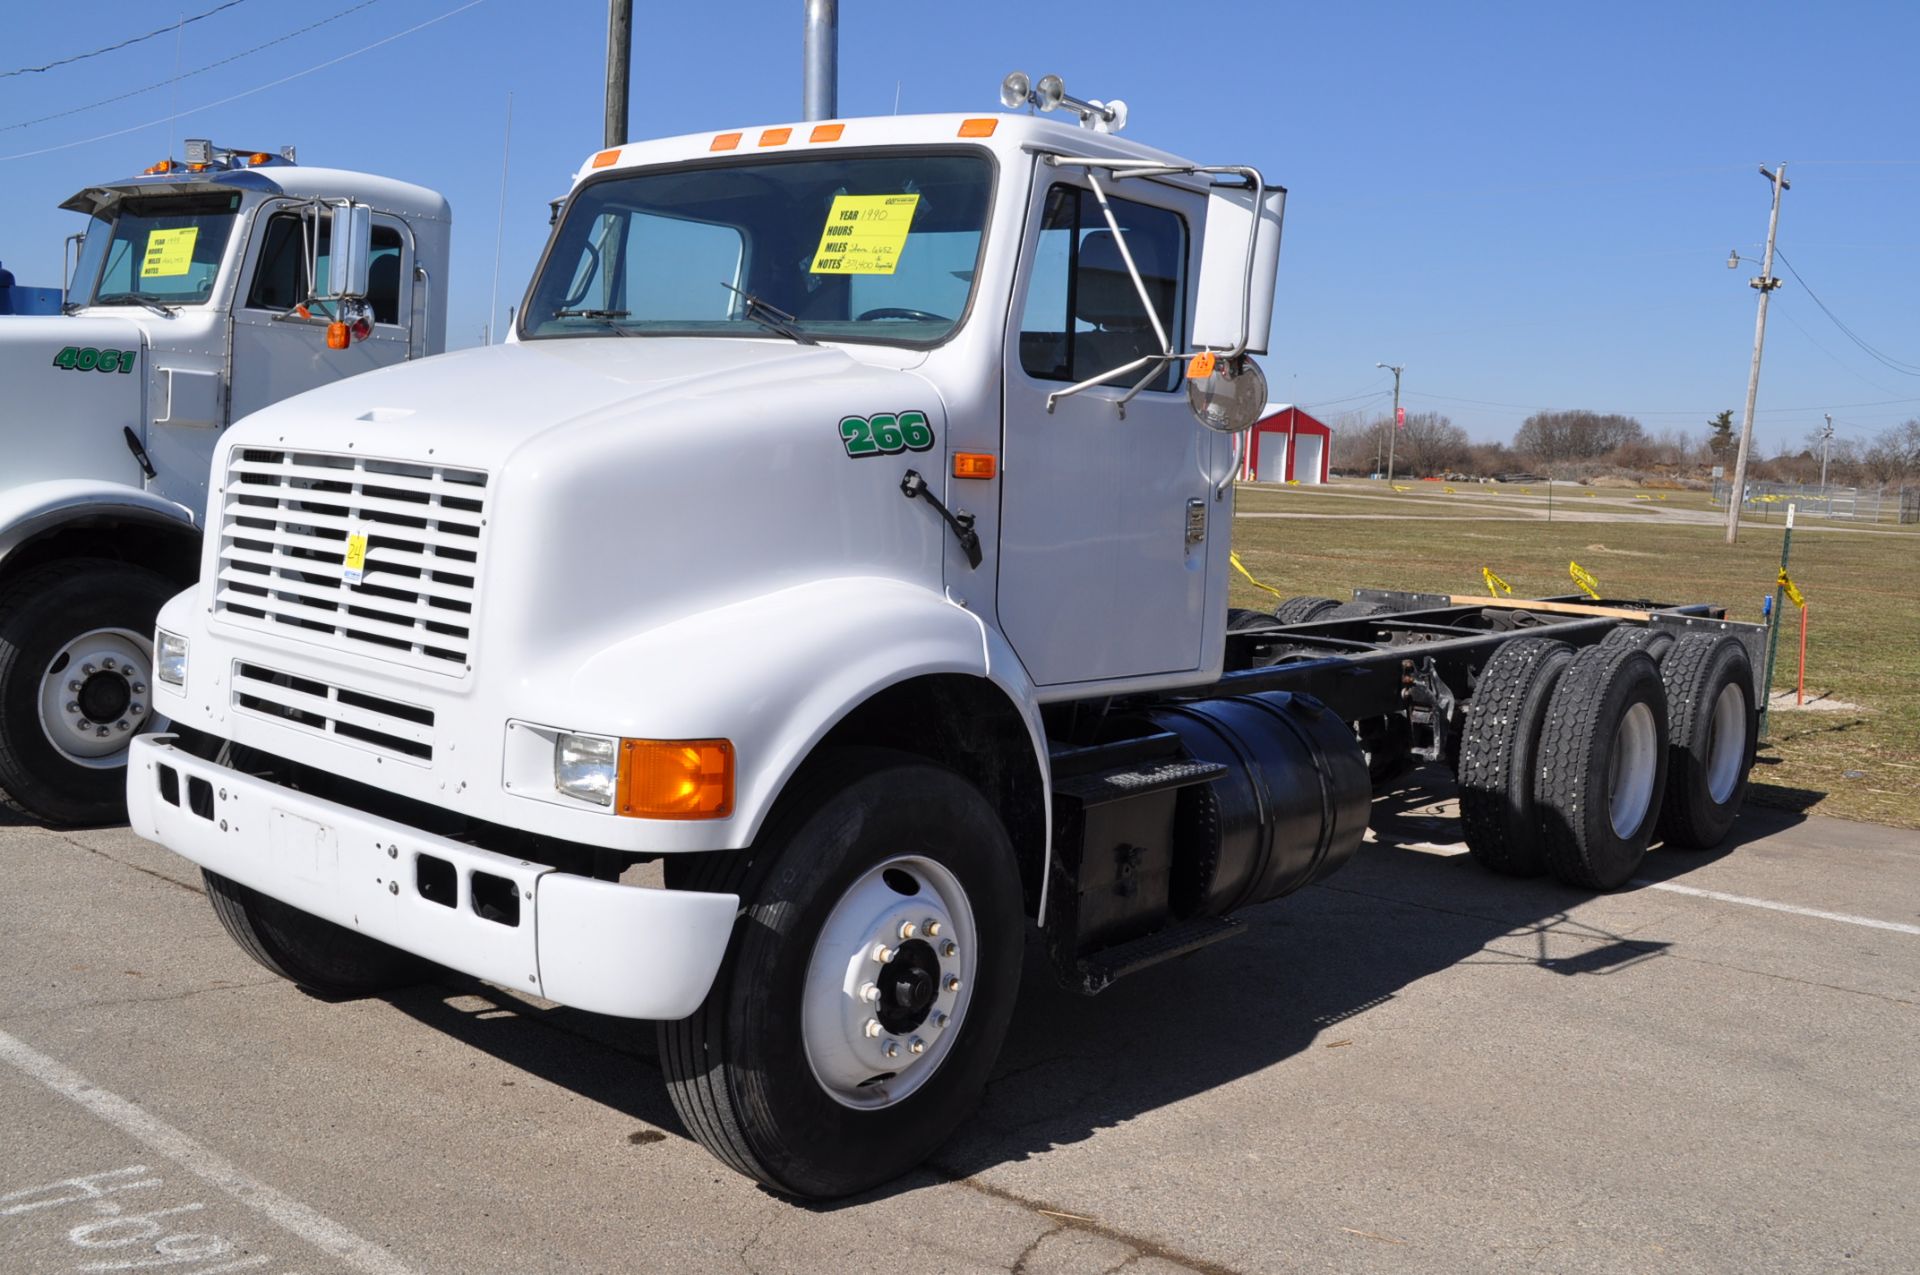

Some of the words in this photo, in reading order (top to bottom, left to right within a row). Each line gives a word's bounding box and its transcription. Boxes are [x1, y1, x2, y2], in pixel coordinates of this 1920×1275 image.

[839, 210, 859, 221] YEAR
[860, 209, 889, 221] 1990
[827, 225, 853, 236] HOURS
[825, 242, 848, 253] MILES
[817, 258, 842, 269] NOTES
[53, 346, 137, 374] 4061
[838, 410, 935, 460] 266
[347, 543, 363, 564] 24
